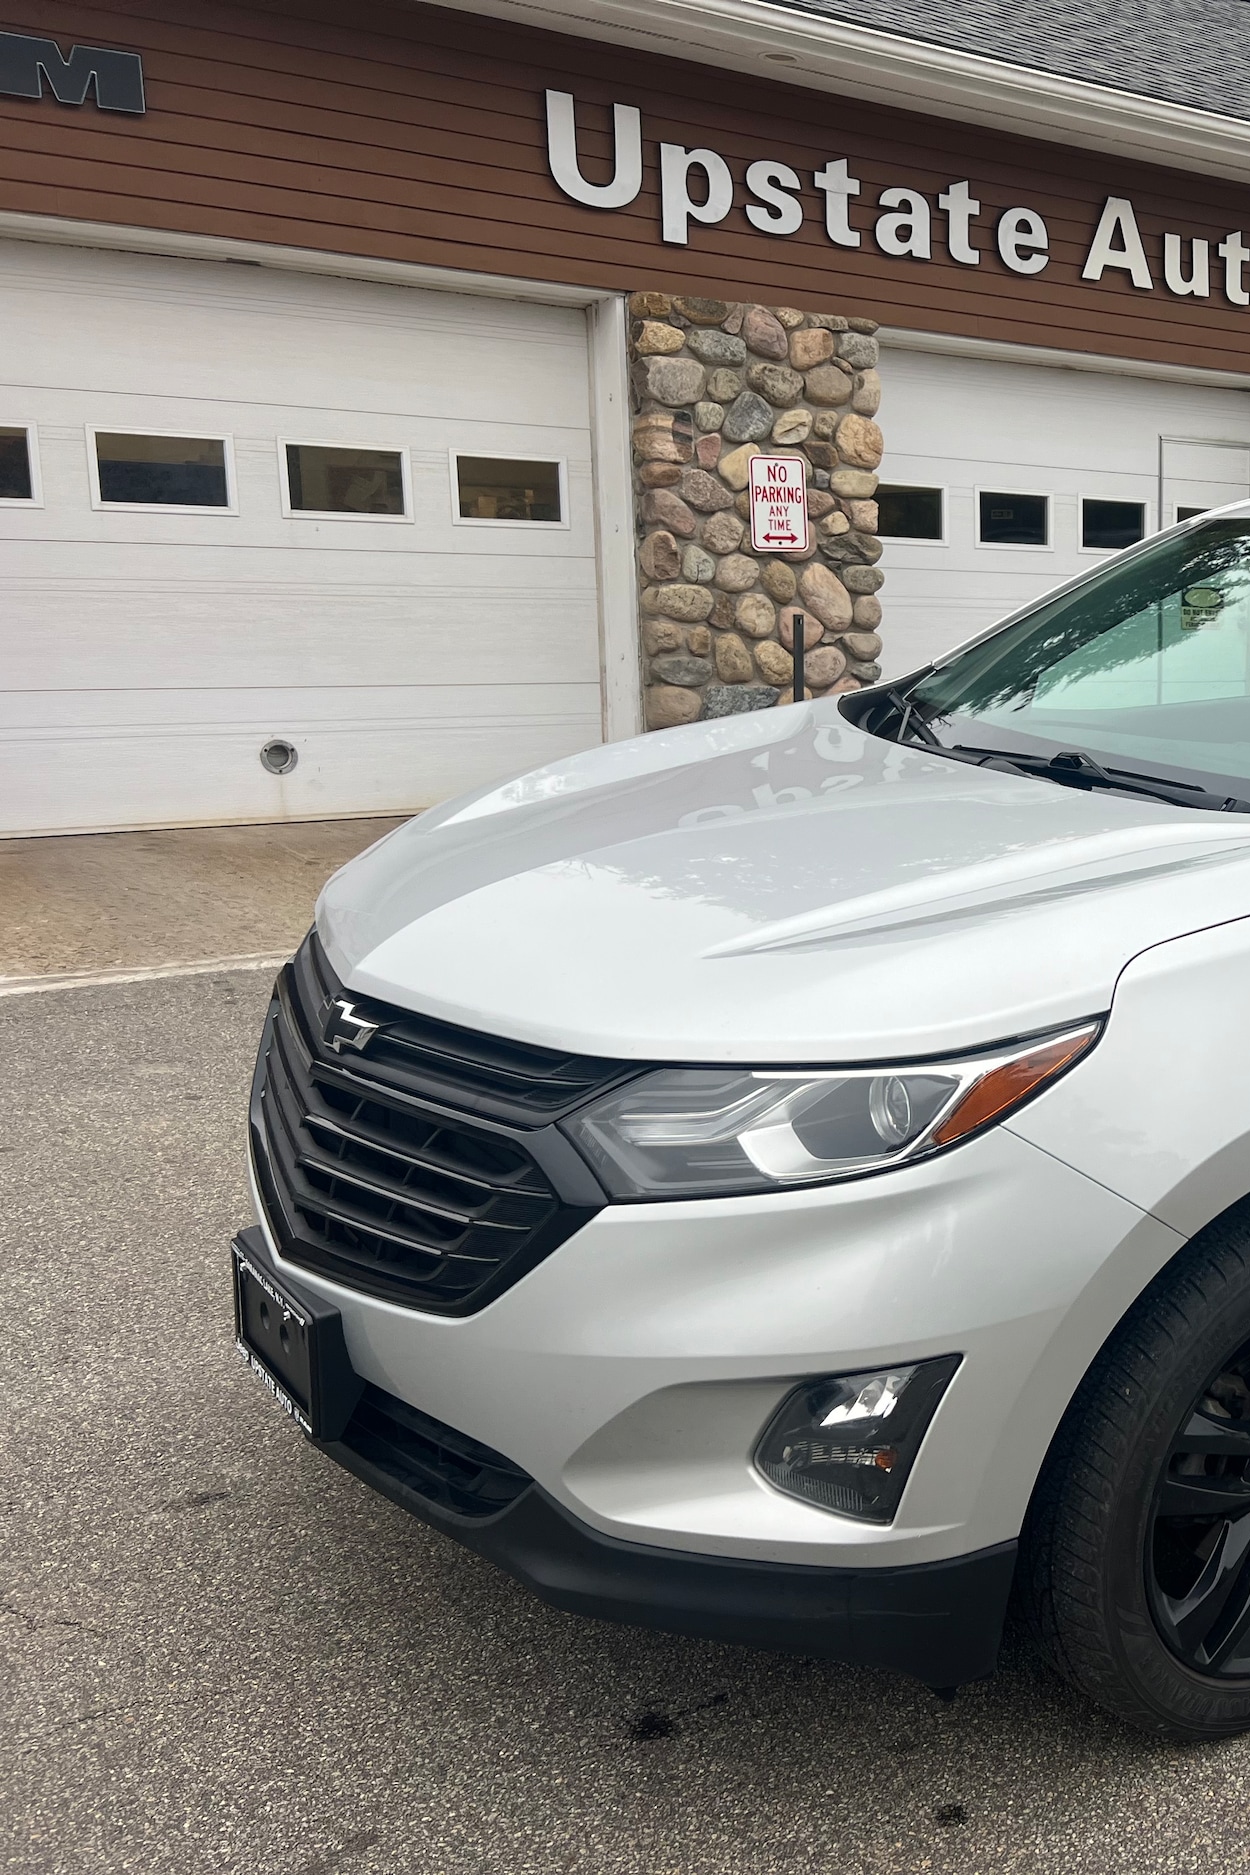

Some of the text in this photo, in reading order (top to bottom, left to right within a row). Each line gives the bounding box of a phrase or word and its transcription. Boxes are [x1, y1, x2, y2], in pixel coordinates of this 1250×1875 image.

[545, 88, 1050, 275] Upstate
[767, 465, 787, 483] NO
[755, 485, 802, 504] PARKING
[769, 505, 789, 518] ANY
[768, 519, 792, 531] TIME
[250, 1354, 275, 1396] UPSTATE
[275, 1386, 293, 1415] AUTO
